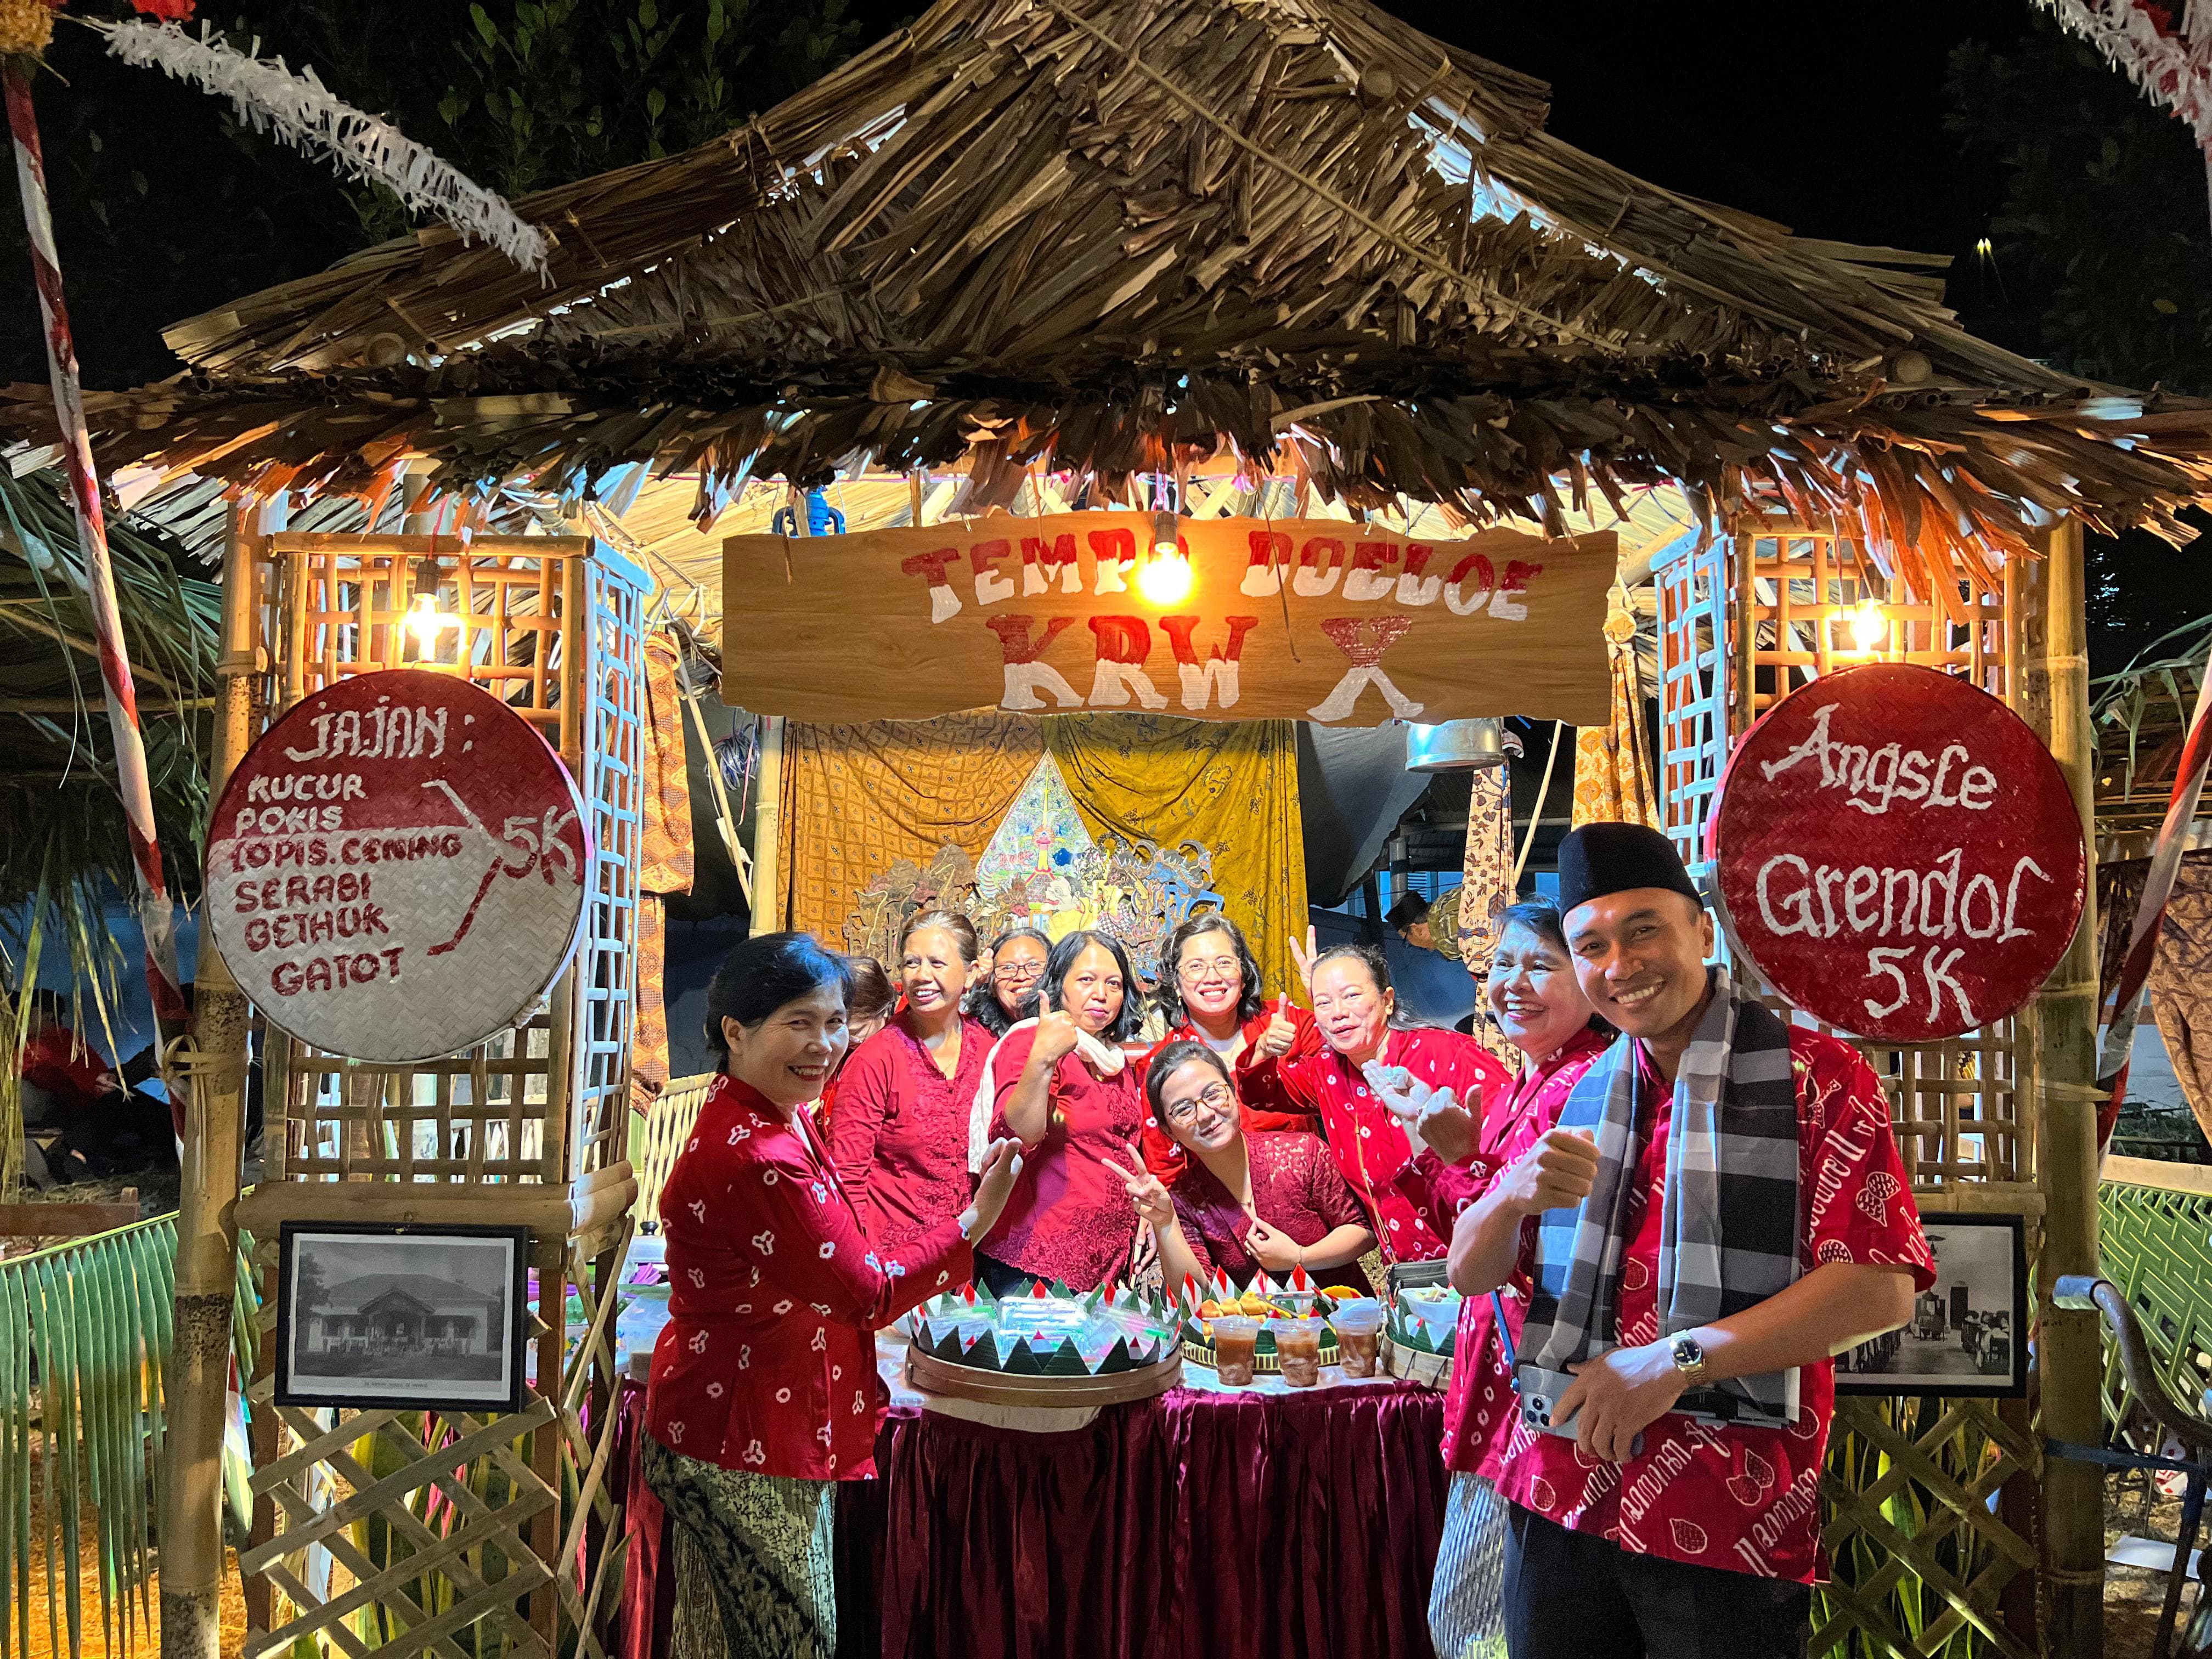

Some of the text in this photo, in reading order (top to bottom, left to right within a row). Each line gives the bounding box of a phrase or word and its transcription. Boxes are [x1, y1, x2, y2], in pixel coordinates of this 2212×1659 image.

[901, 528, 1188, 624] TEMP
[986, 614, 1424, 722] KRW X
[248, 774, 368, 803] KUCUR
[504, 805, 583, 885] 5K
[235, 872, 372, 913] SERABI
[245, 902, 390, 952] GETHUK
[1756, 848, 2054, 944] Grendol
[271, 947, 405, 996] GATOT
[1864, 945, 1980, 1027] 5K
